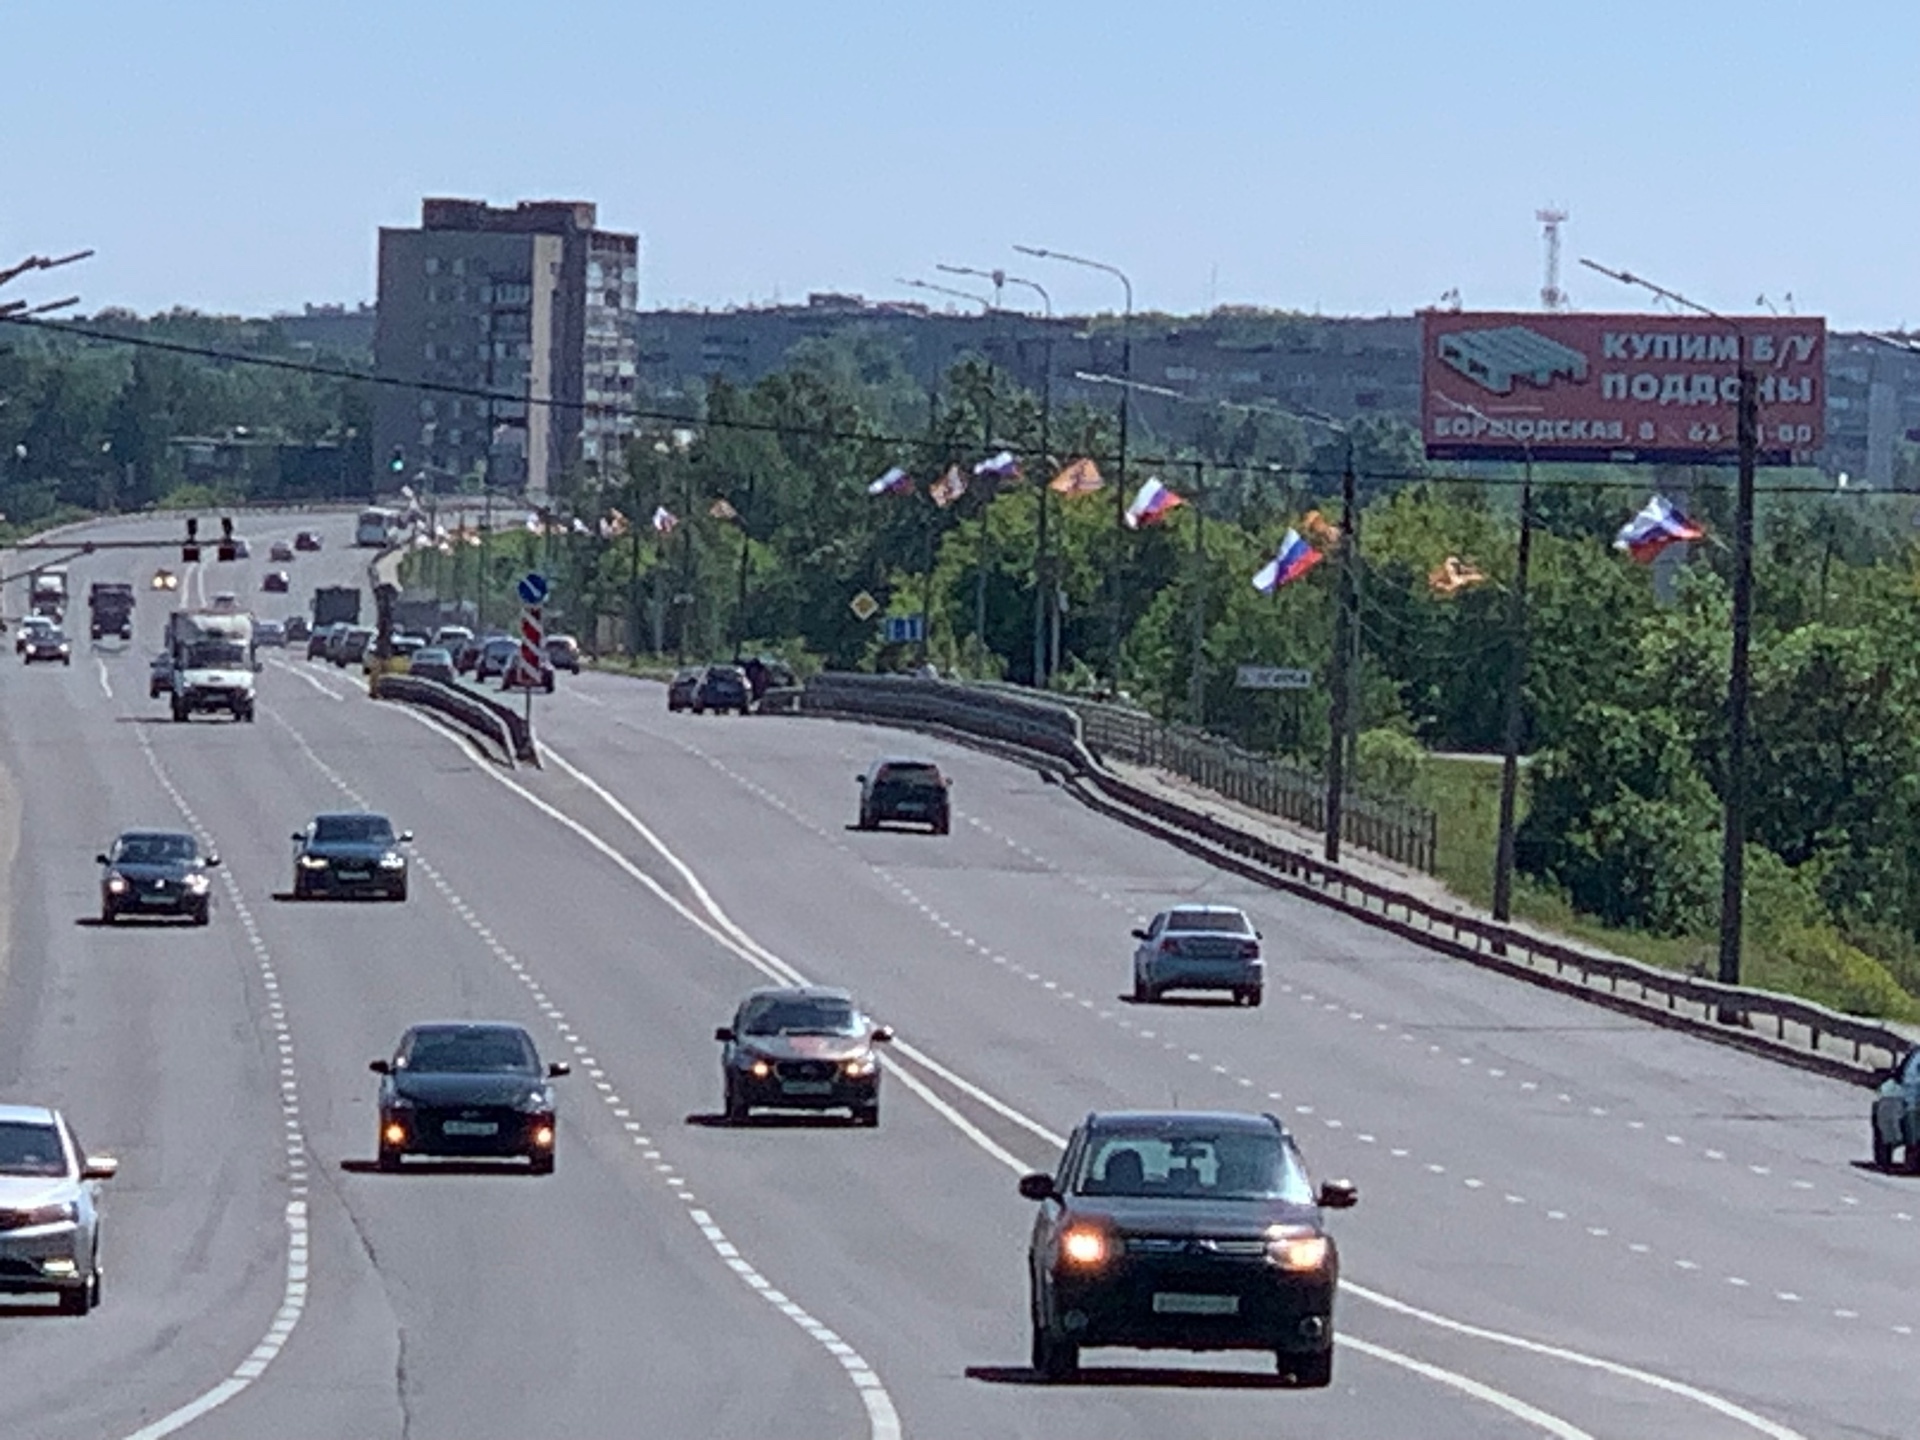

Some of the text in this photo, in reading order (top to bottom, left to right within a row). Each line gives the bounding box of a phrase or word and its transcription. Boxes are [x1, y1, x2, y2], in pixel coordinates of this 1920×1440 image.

[1603, 333, 1817, 370] КУПИМ Б/У
[1602, 372, 1812, 406] ПОДДОНЫ
